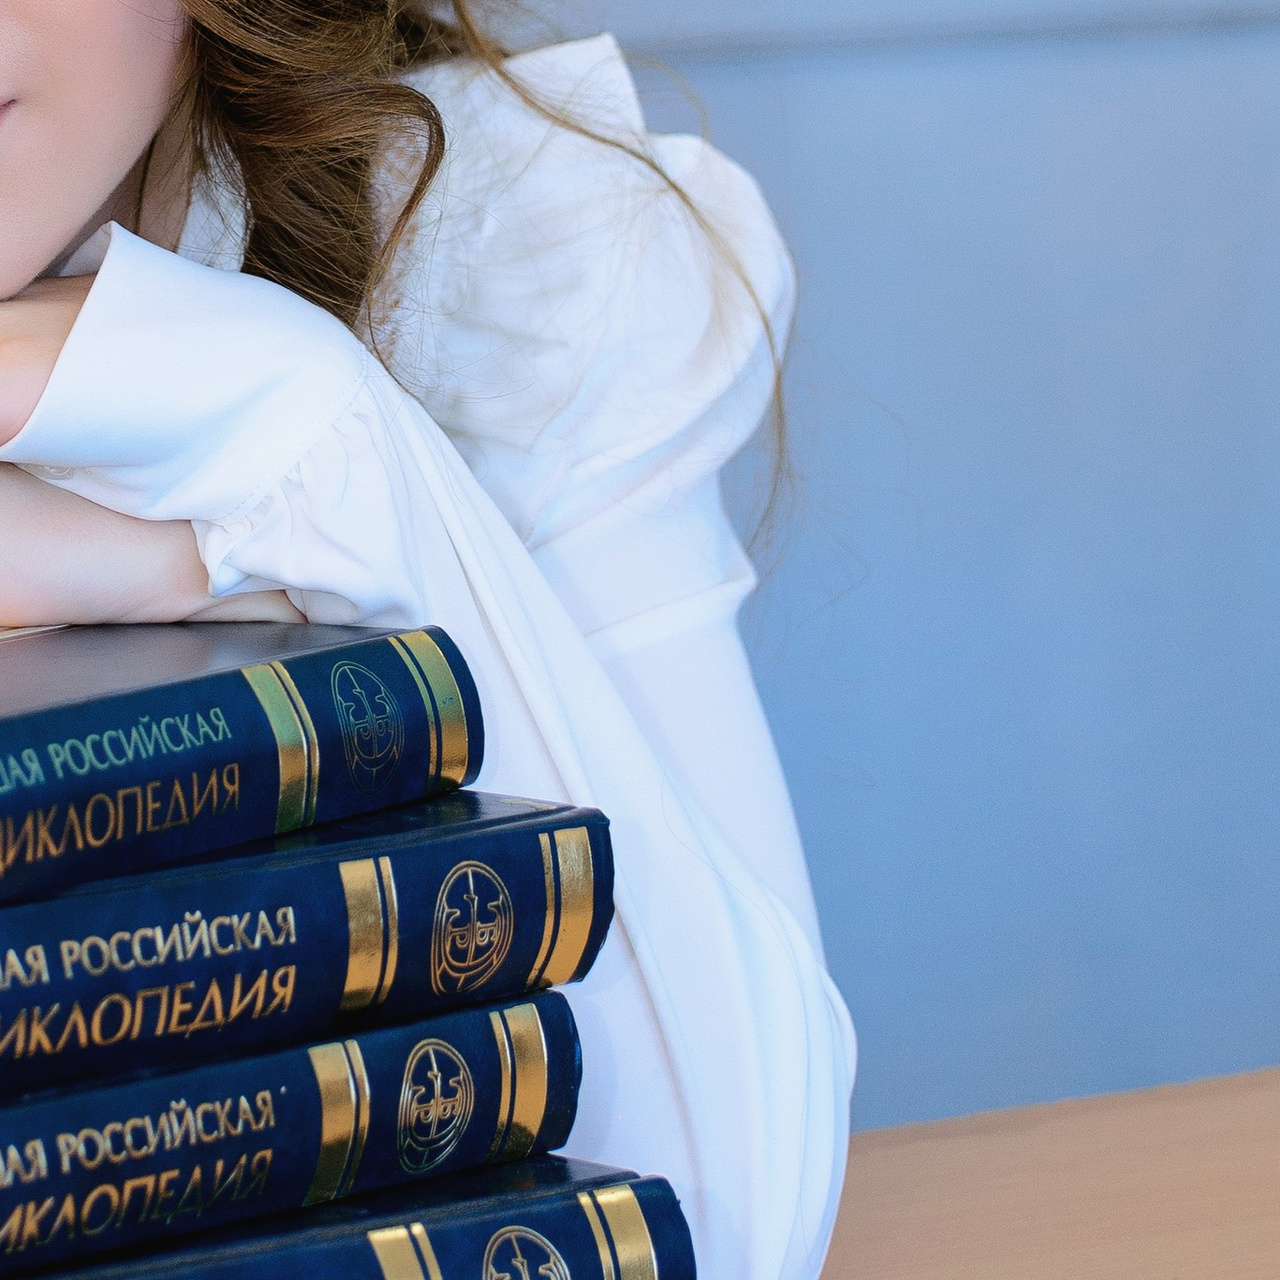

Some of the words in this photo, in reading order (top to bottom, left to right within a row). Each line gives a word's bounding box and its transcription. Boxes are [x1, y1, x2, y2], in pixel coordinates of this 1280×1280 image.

[47, 707, 232, 778] РОССИЙСКАЯ
[60, 906, 297, 979] РОССИЙСКАЯ
[60, 1090, 276, 1174] РОССИЙСКАЯ
